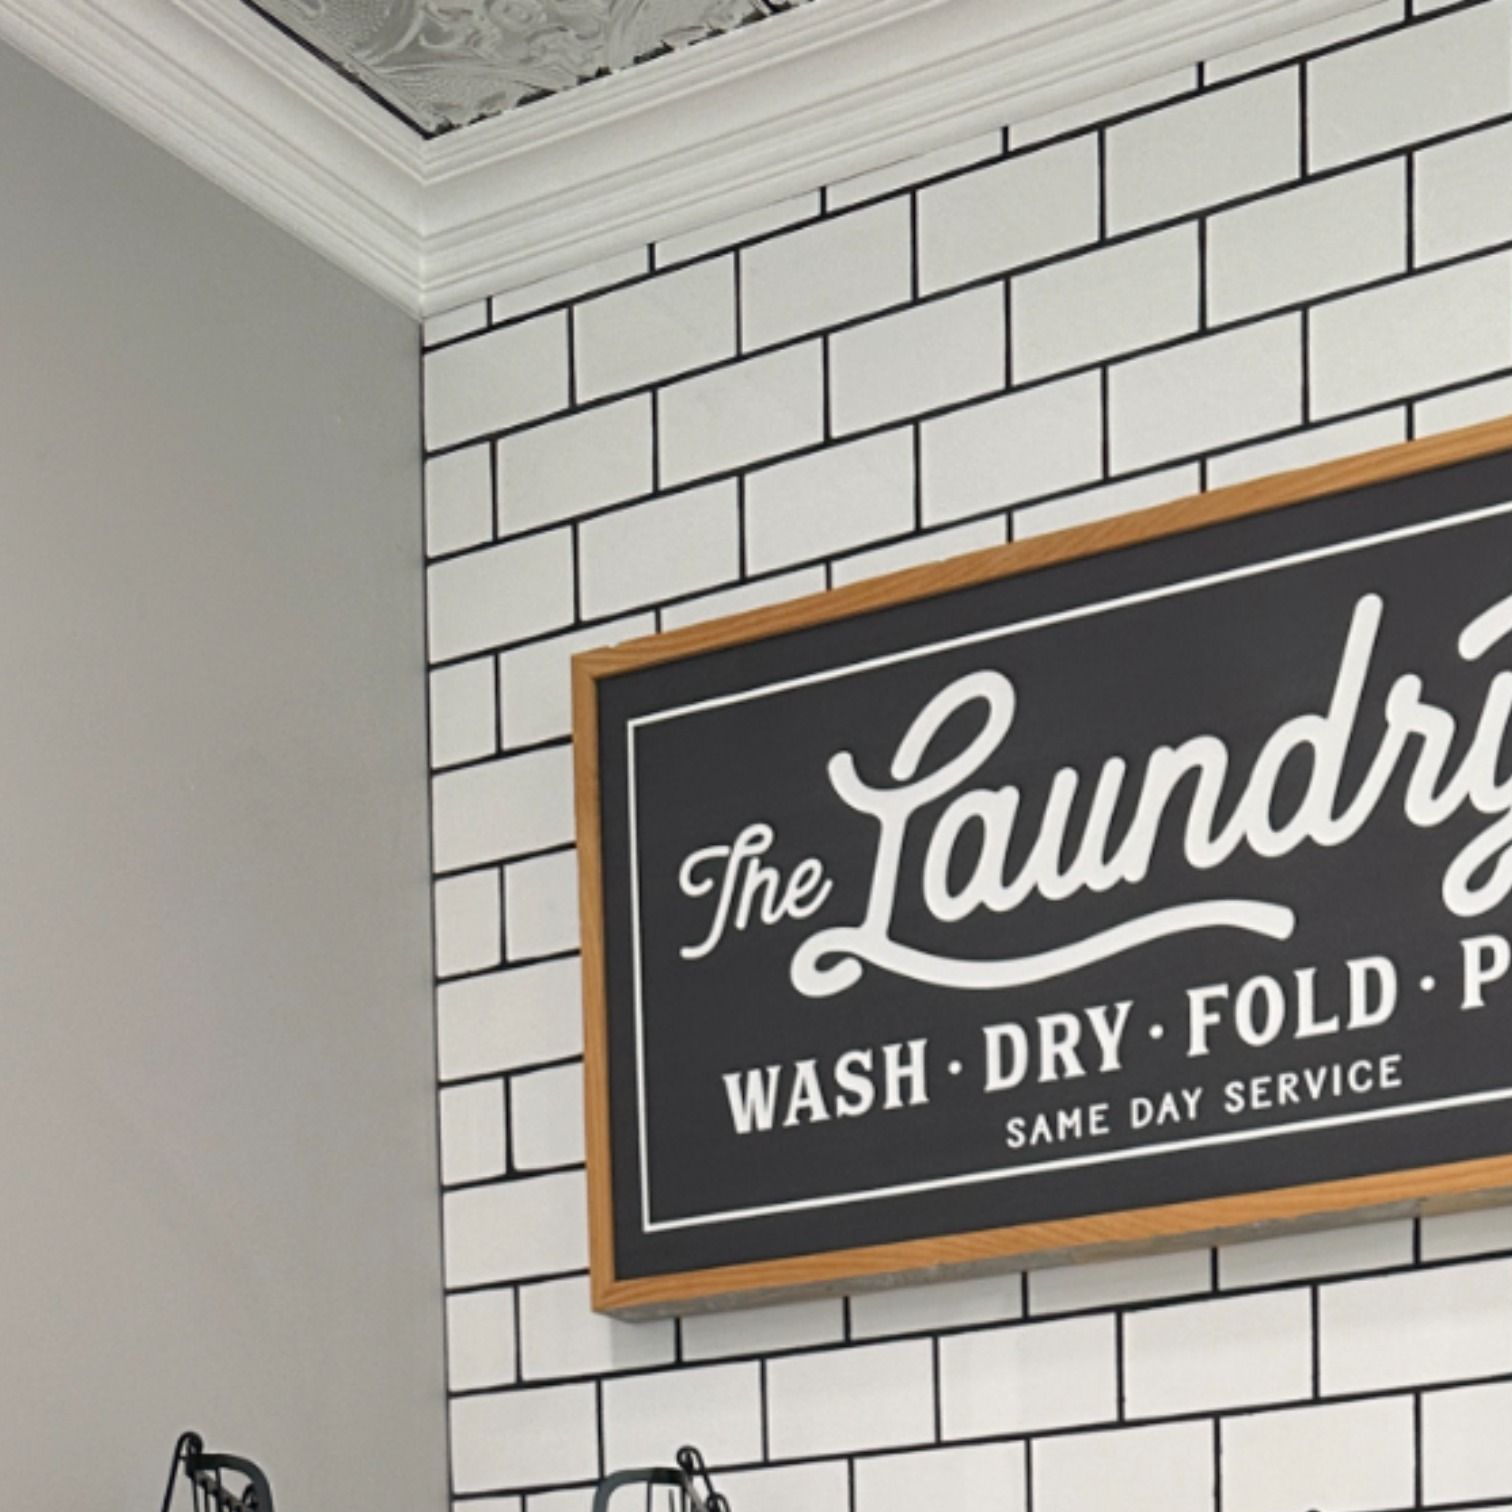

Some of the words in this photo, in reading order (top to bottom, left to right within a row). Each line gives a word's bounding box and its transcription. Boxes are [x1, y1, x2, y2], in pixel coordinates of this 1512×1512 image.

[679, 822, 833, 959] The
[722, 1039, 928, 1134] WASH
[983, 1000, 1132, 1092] DRY
[1186, 956, 1397, 1057] FOLD
[1006, 1102, 1110, 1149] SAME
[1130, 1086, 1203, 1130] DAY
[1223, 1053, 1403, 1115] SERVICE
